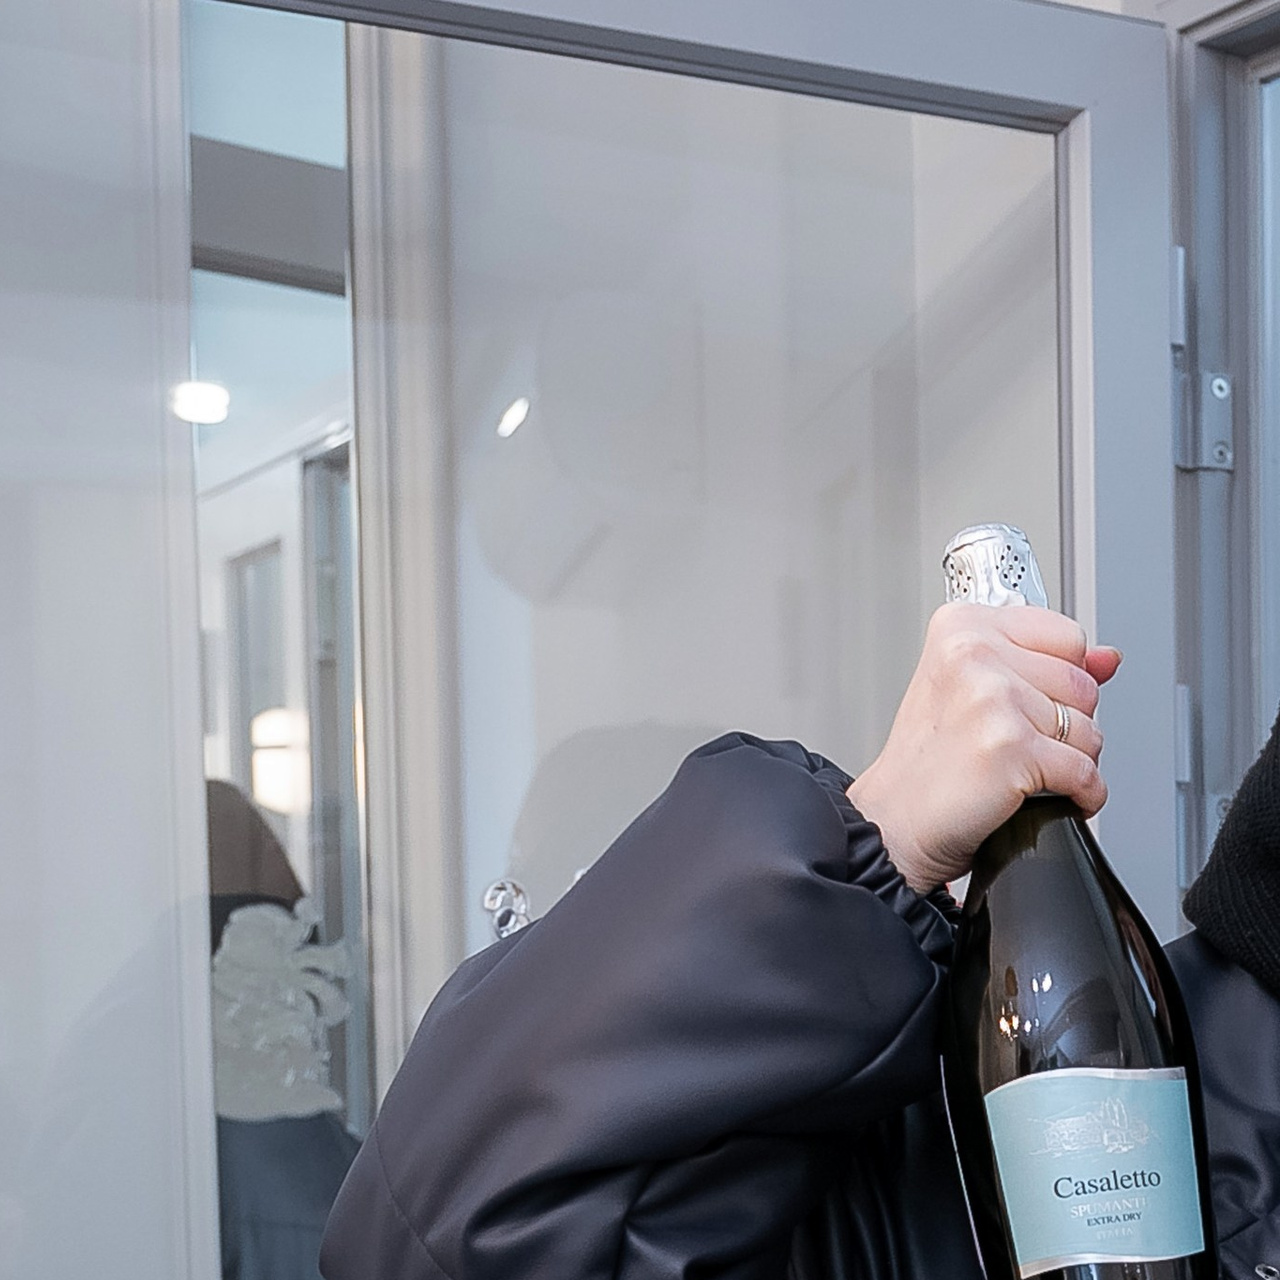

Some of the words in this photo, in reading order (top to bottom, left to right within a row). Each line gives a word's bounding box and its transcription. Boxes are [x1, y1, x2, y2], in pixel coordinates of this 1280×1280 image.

[1054, 1170, 1161, 1198] Casaletto
[1087, 1216, 1121, 1227] EXTRA
[1123, 1212, 1142, 1222] DRY
